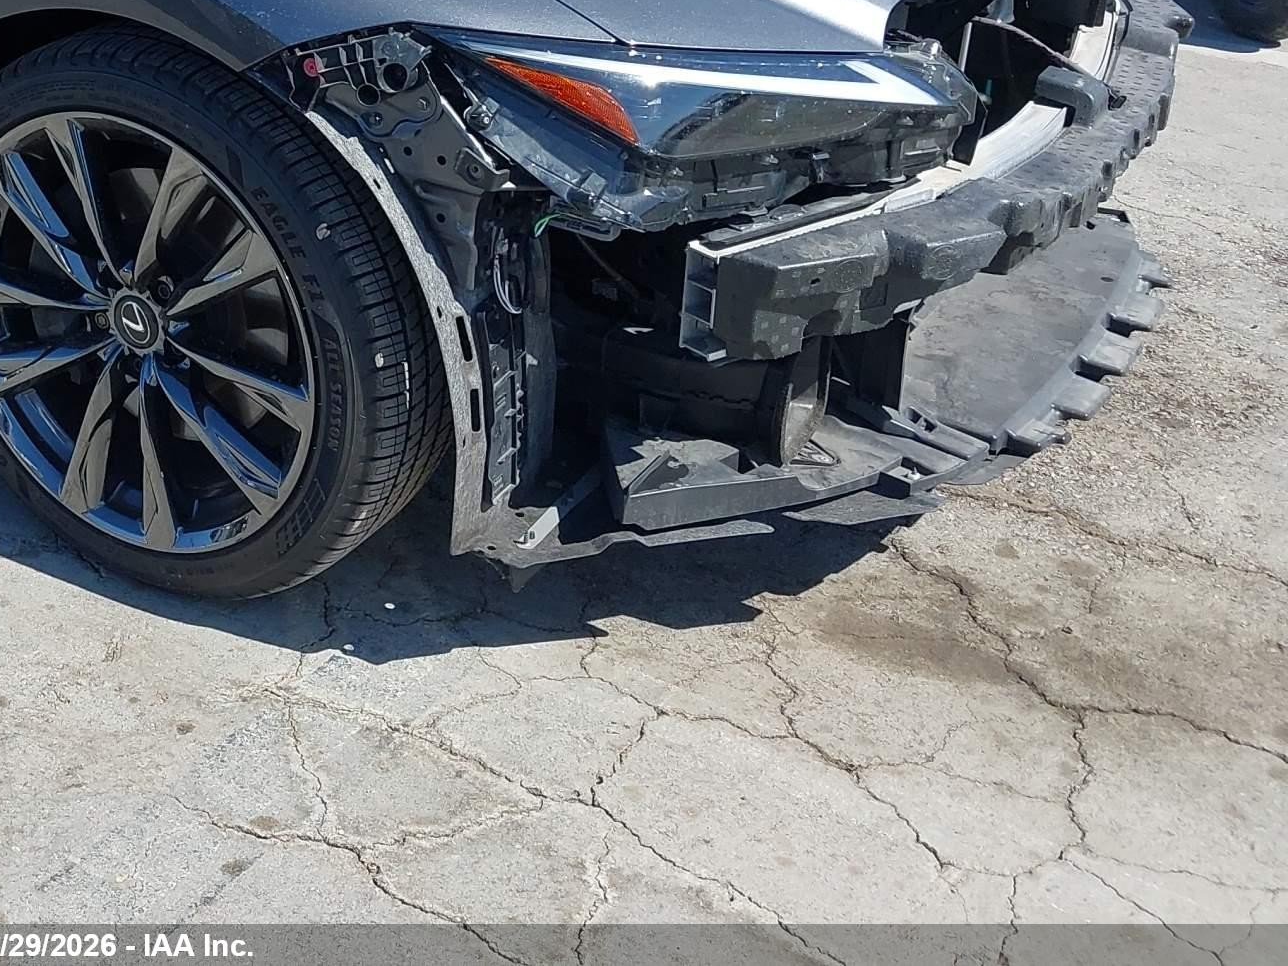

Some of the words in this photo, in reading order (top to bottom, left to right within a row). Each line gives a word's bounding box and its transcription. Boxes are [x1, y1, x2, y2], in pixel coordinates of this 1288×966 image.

[251, 186, 306, 259] EAGLE
[302, 274, 326, 301] F1
[321, 337, 342, 371] ALL
[326, 383, 345, 452] SEASON
